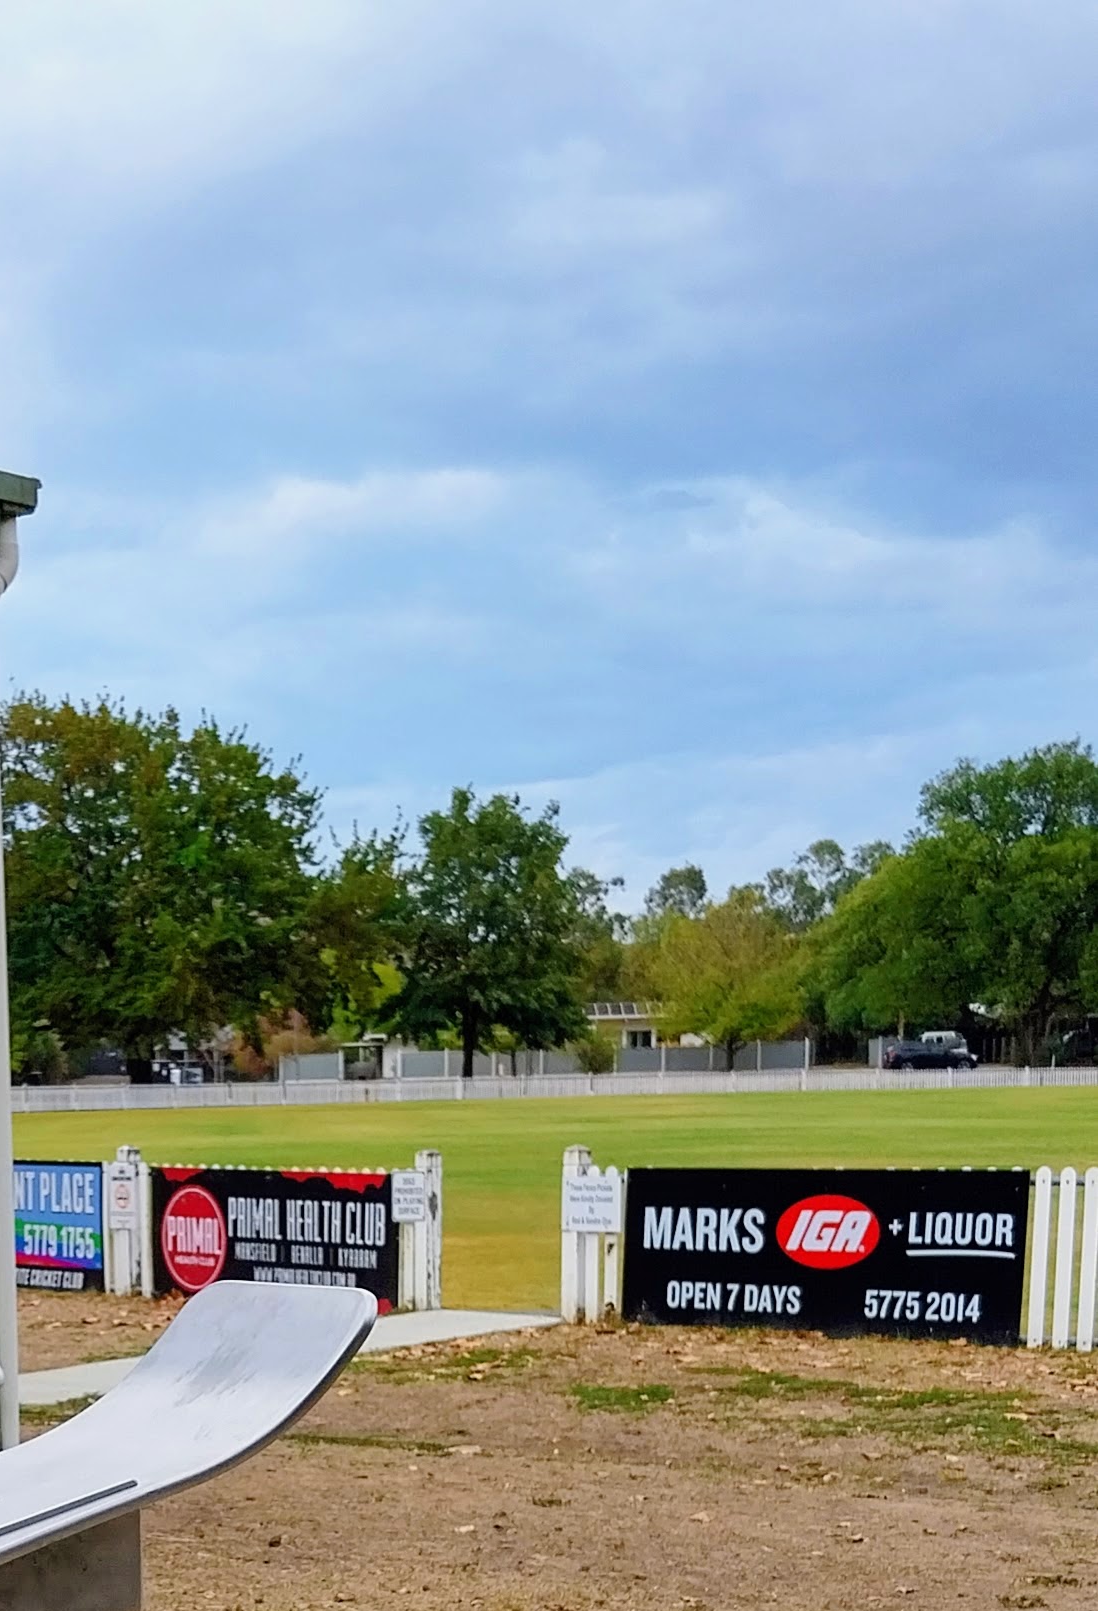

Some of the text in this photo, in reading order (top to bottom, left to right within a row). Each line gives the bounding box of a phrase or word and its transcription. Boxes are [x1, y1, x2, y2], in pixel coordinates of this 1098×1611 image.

[39, 1171, 94, 1214] PLACE
[167, 1215, 223, 1255] PRIMAL
[228, 1197, 385, 1246] PRIMAL HEALTH CLUB
[643, 1206, 765, 1254] MARKS
[786, 1209, 871, 1253] IGA
[908, 1211, 1014, 1247] LIQUOR
[23, 1223, 95, 1259] 5779 1755
[234, 1242, 277, 1263] MANSFIELD
[30, 1271, 62, 1288] CRICKET
[62, 1272, 84, 1289] CLUB
[666, 1280, 801, 1315] OPEN 7 DAYS
[864, 1289, 981, 1324] 5775 2014
